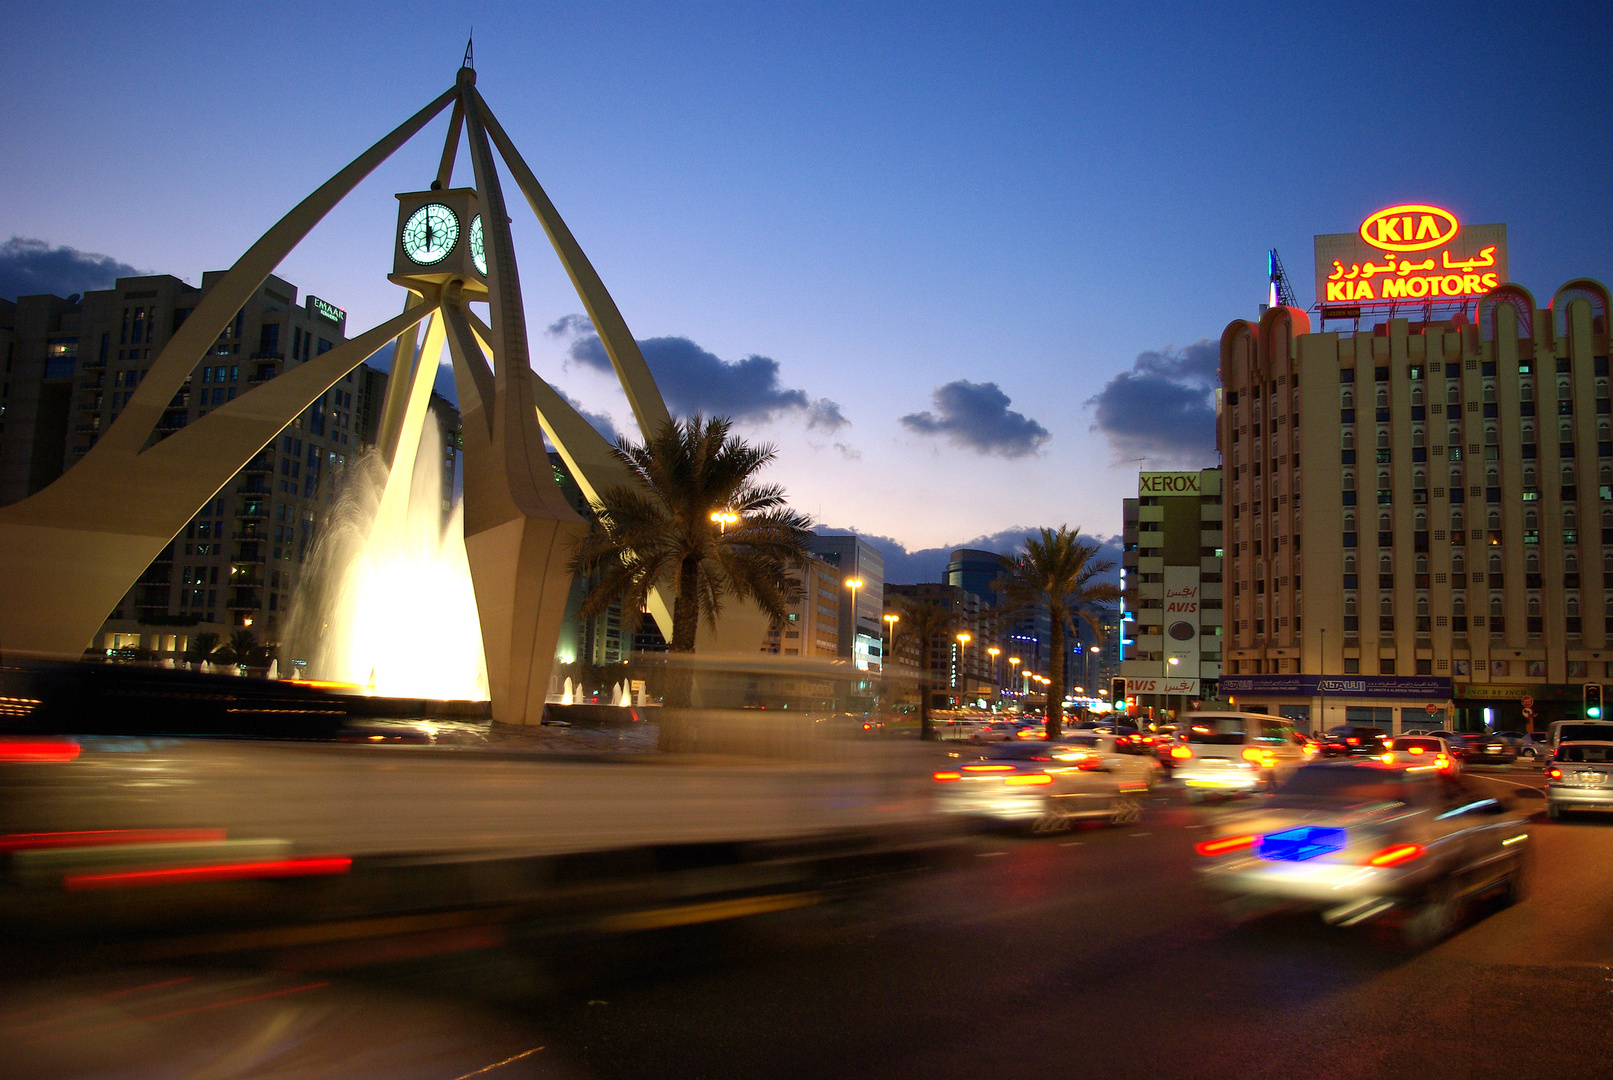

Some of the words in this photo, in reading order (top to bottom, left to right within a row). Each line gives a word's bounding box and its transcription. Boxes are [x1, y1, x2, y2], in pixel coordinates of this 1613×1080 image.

[1376, 215, 1441, 242] KIA
[1327, 252, 1436, 280] موتورز
[1442, 245, 1497, 273] كيا
[1326, 280, 1374, 302] KIA
[1382, 272, 1499, 299] MOTORS
[314, 298, 344, 320] EMAAR
[1140, 475, 1197, 492] XEROX
[1166, 602, 1198, 613] AVIS
[1126, 680, 1157, 691] AVIS
